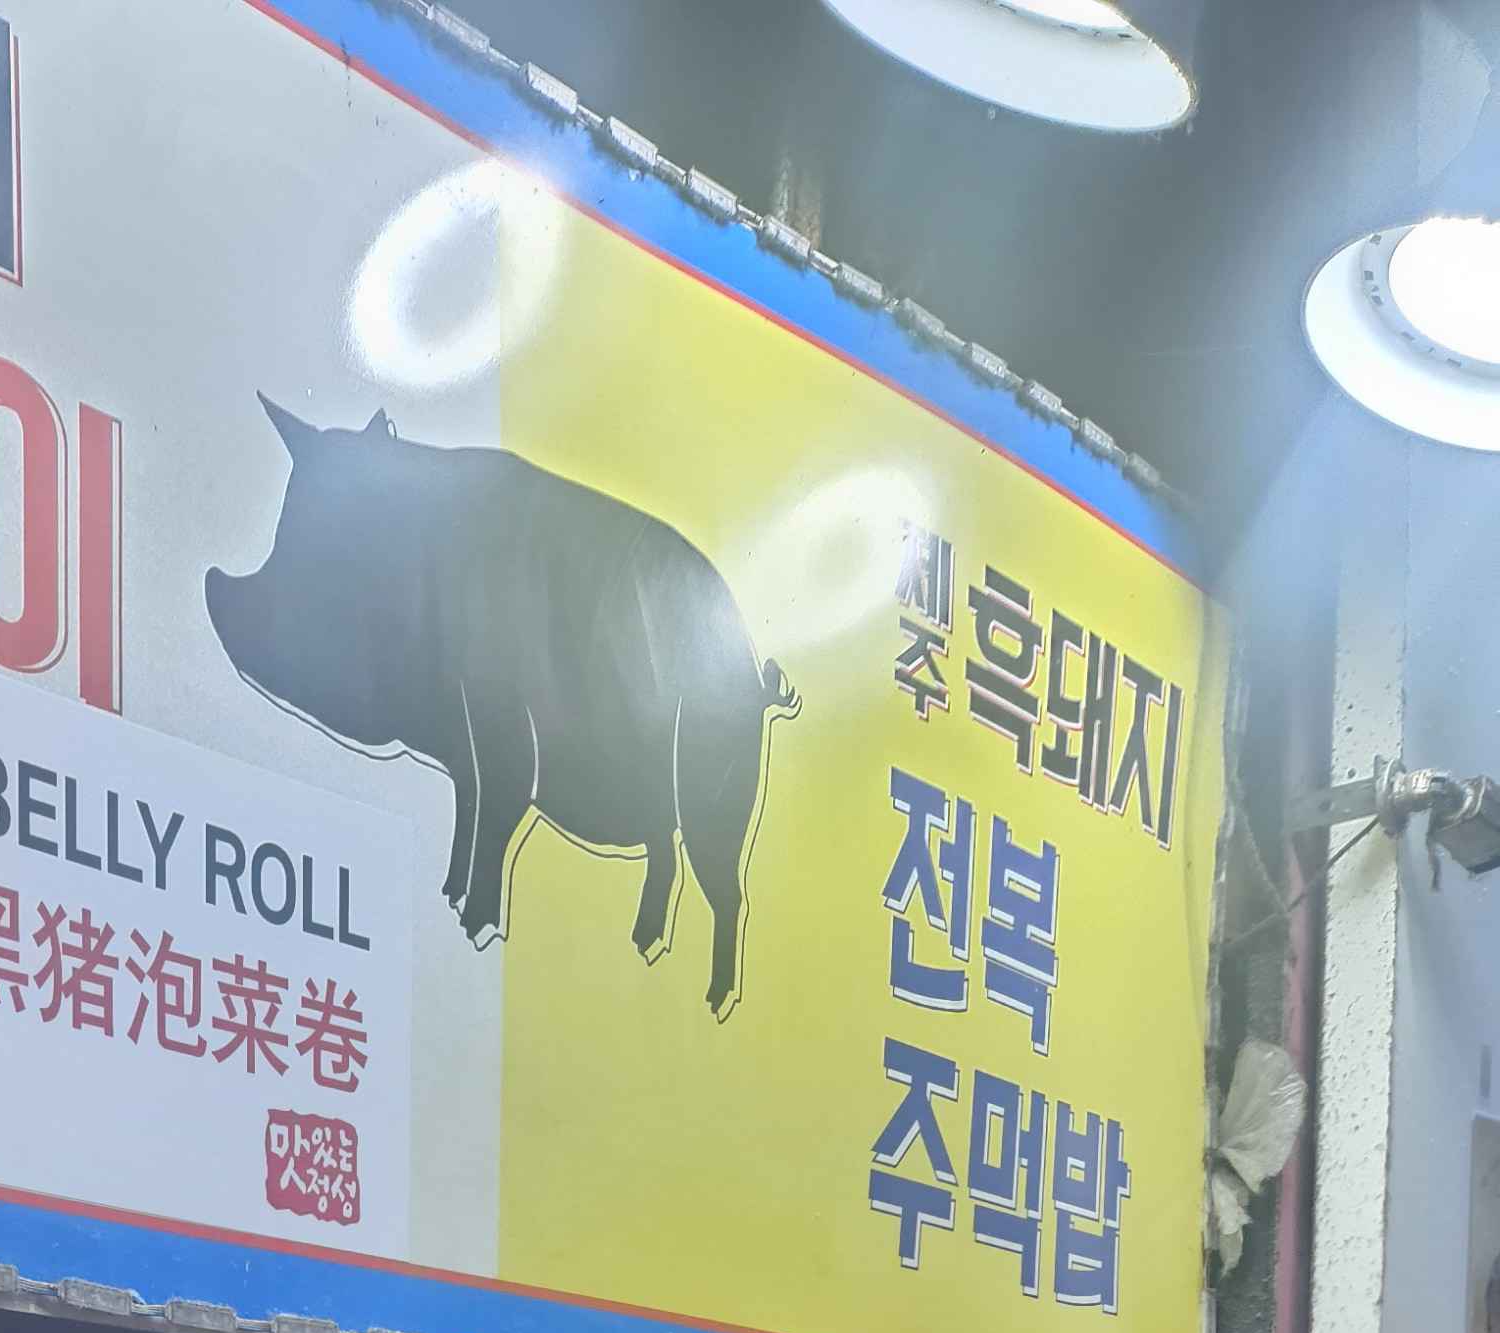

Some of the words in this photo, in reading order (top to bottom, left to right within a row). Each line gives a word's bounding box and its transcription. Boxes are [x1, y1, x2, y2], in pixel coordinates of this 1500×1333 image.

[965, 563, 1184, 851] 흑돼지
[204, 822, 370, 952] ROLL
[882, 766, 1061, 1056] 전복
[269, 1122, 353, 1194] 맛있는
[306, 1168, 357, 1219] 정성
[869, 1036, 1131, 1316] 주먹밥
